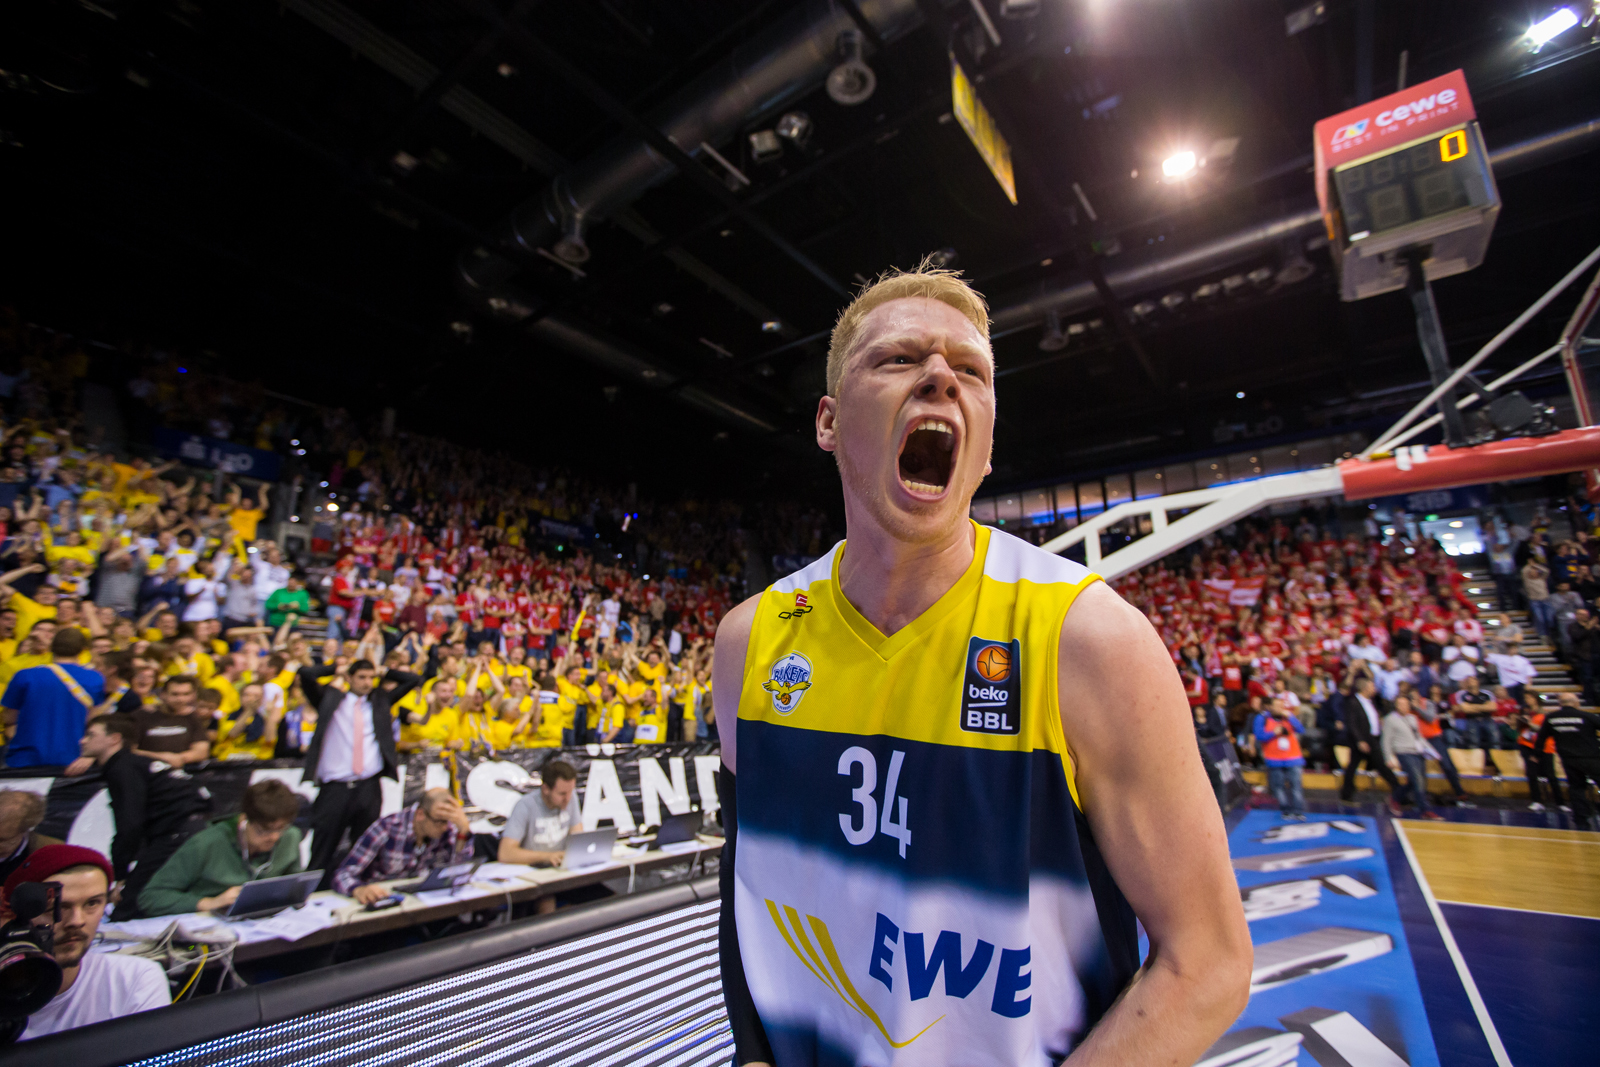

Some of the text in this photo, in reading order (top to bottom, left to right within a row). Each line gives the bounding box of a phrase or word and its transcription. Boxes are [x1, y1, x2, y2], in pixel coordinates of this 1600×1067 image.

[1331, 101, 1460, 153] BEST IN PRINT
[1375, 88, 1458, 127] cewe
[1439, 129, 1468, 162] 0
[968, 683, 1009, 702] beko
[967, 710, 1013, 731] BBL
[837, 746, 912, 859] 34
[868, 911, 1032, 1019] EWE
